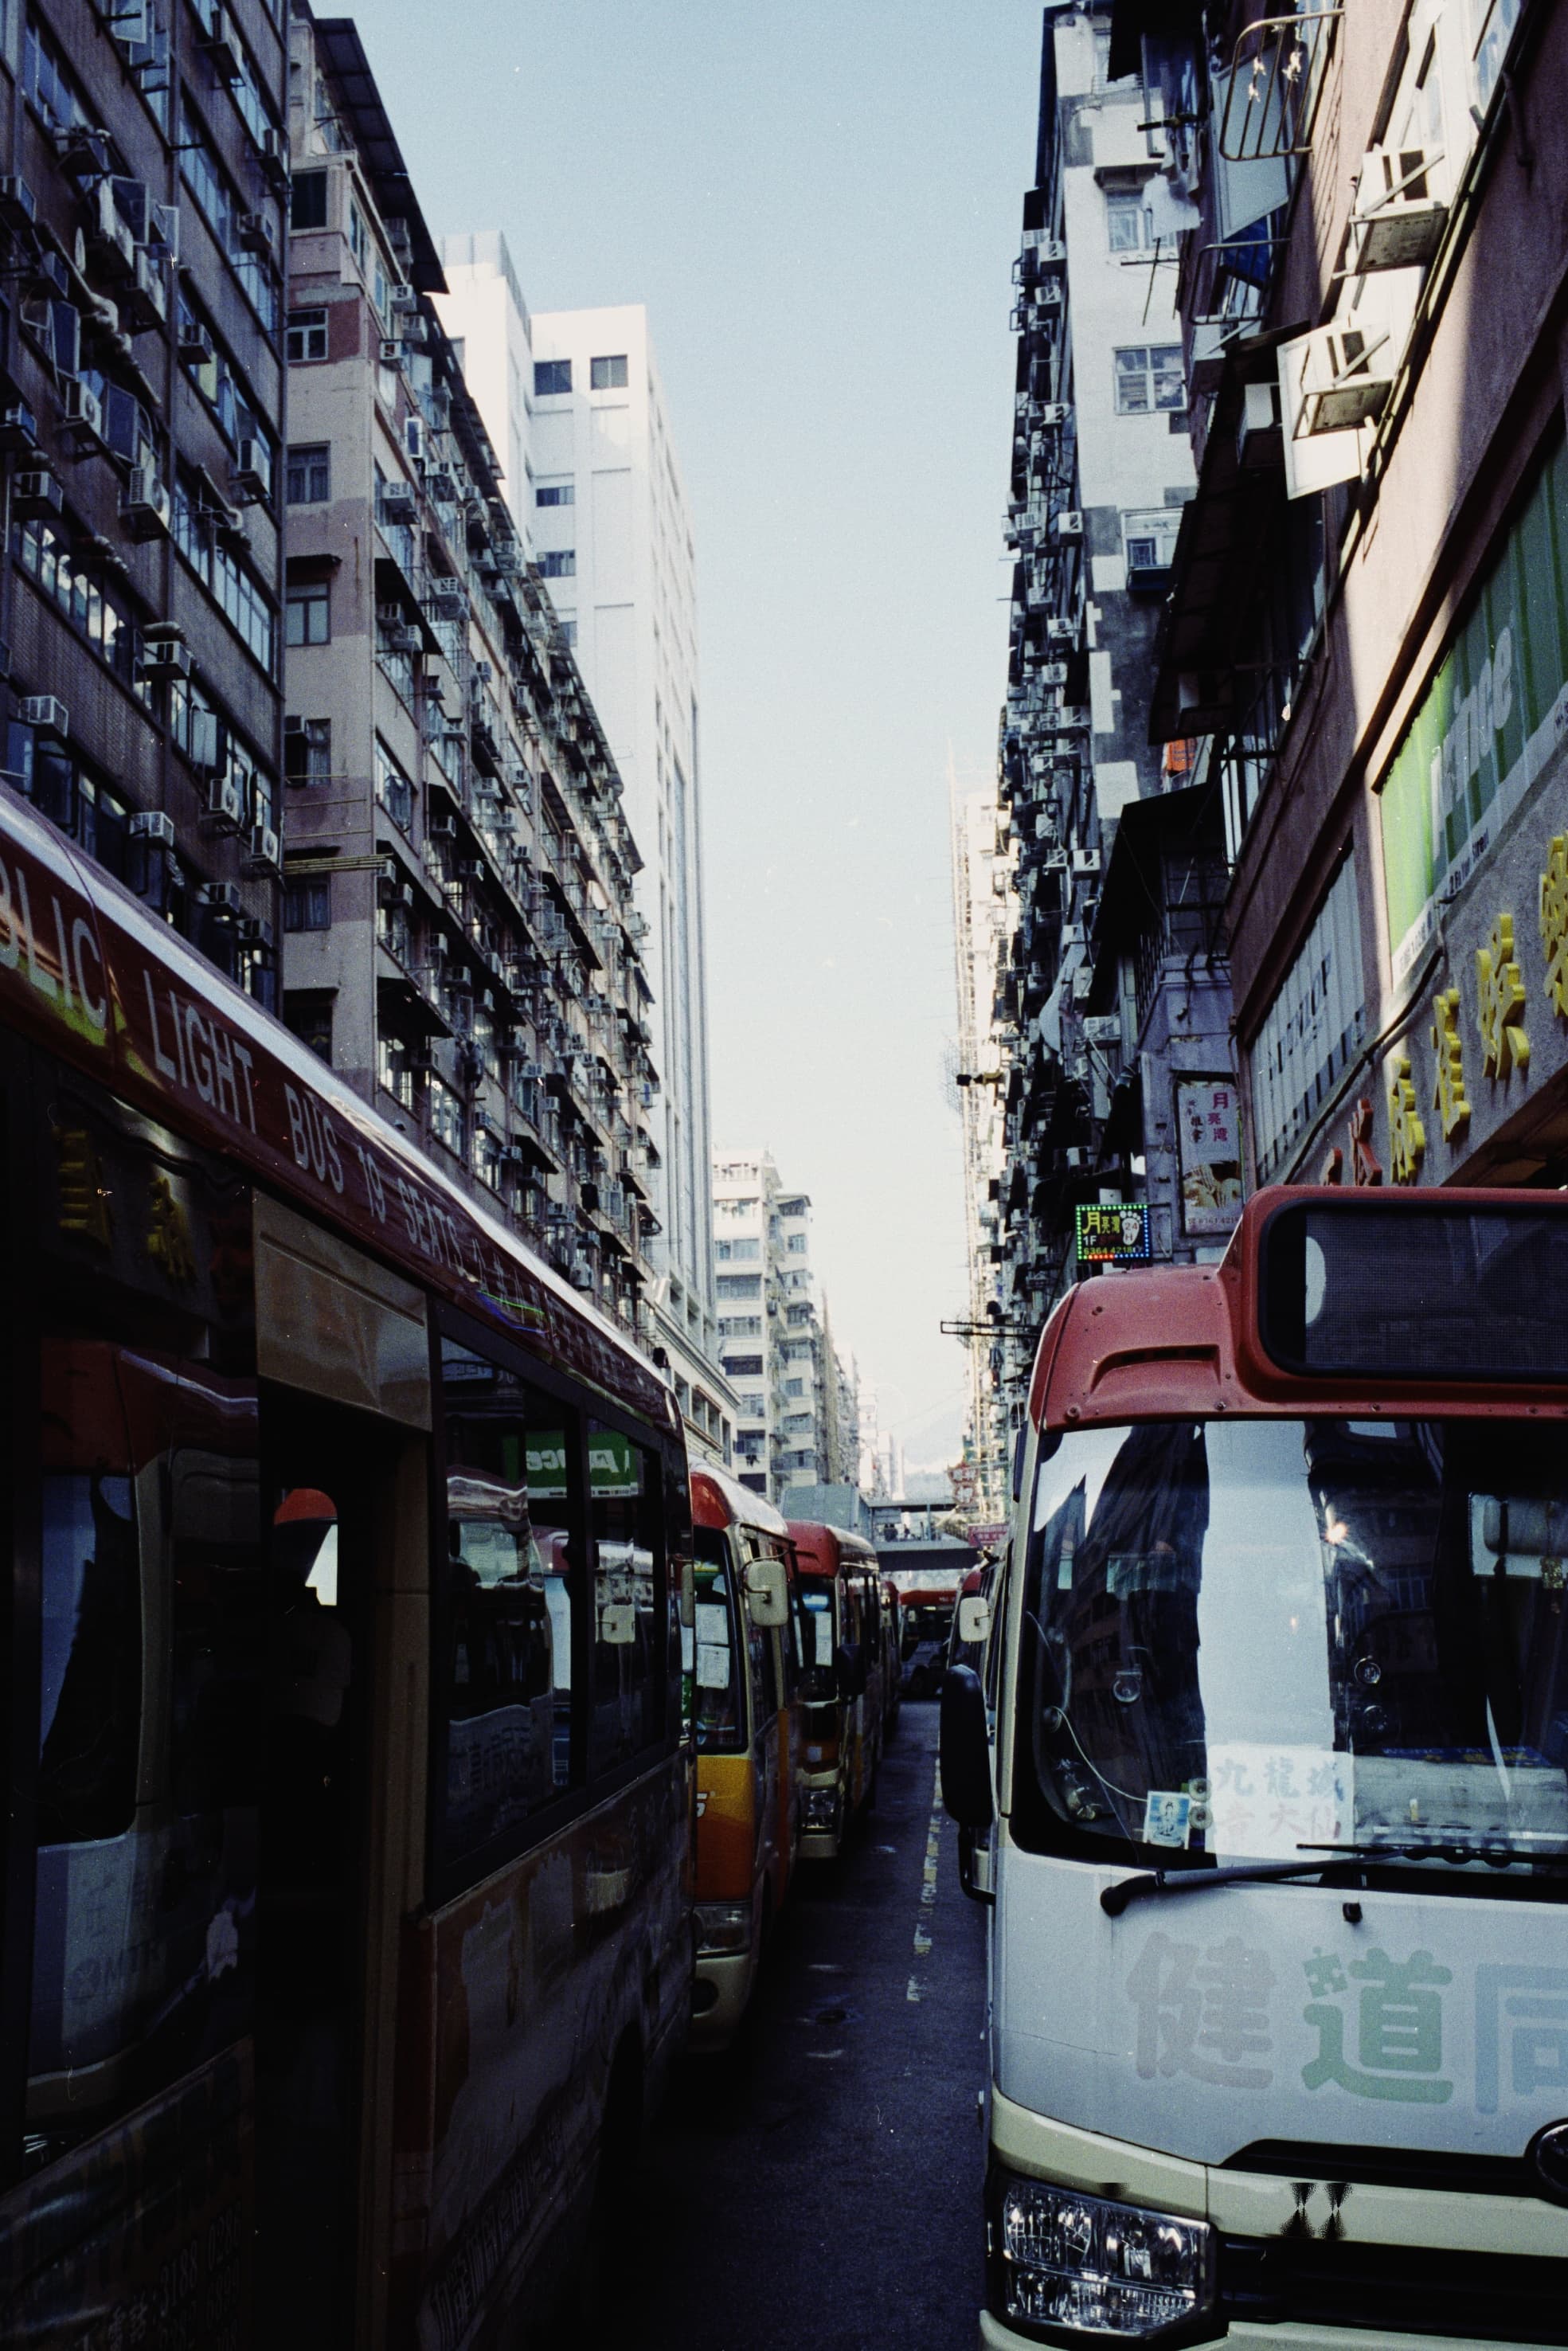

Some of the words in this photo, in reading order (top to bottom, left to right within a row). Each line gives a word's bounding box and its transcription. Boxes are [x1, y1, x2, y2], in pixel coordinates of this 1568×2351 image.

[143, 969, 260, 1136] LIGHT
[283, 1082, 345, 1194] BUS
[356, 1143, 388, 1224] 19
[397, 1176, 468, 1276] SEATS
[1083, 1235, 1097, 1246] 1F
